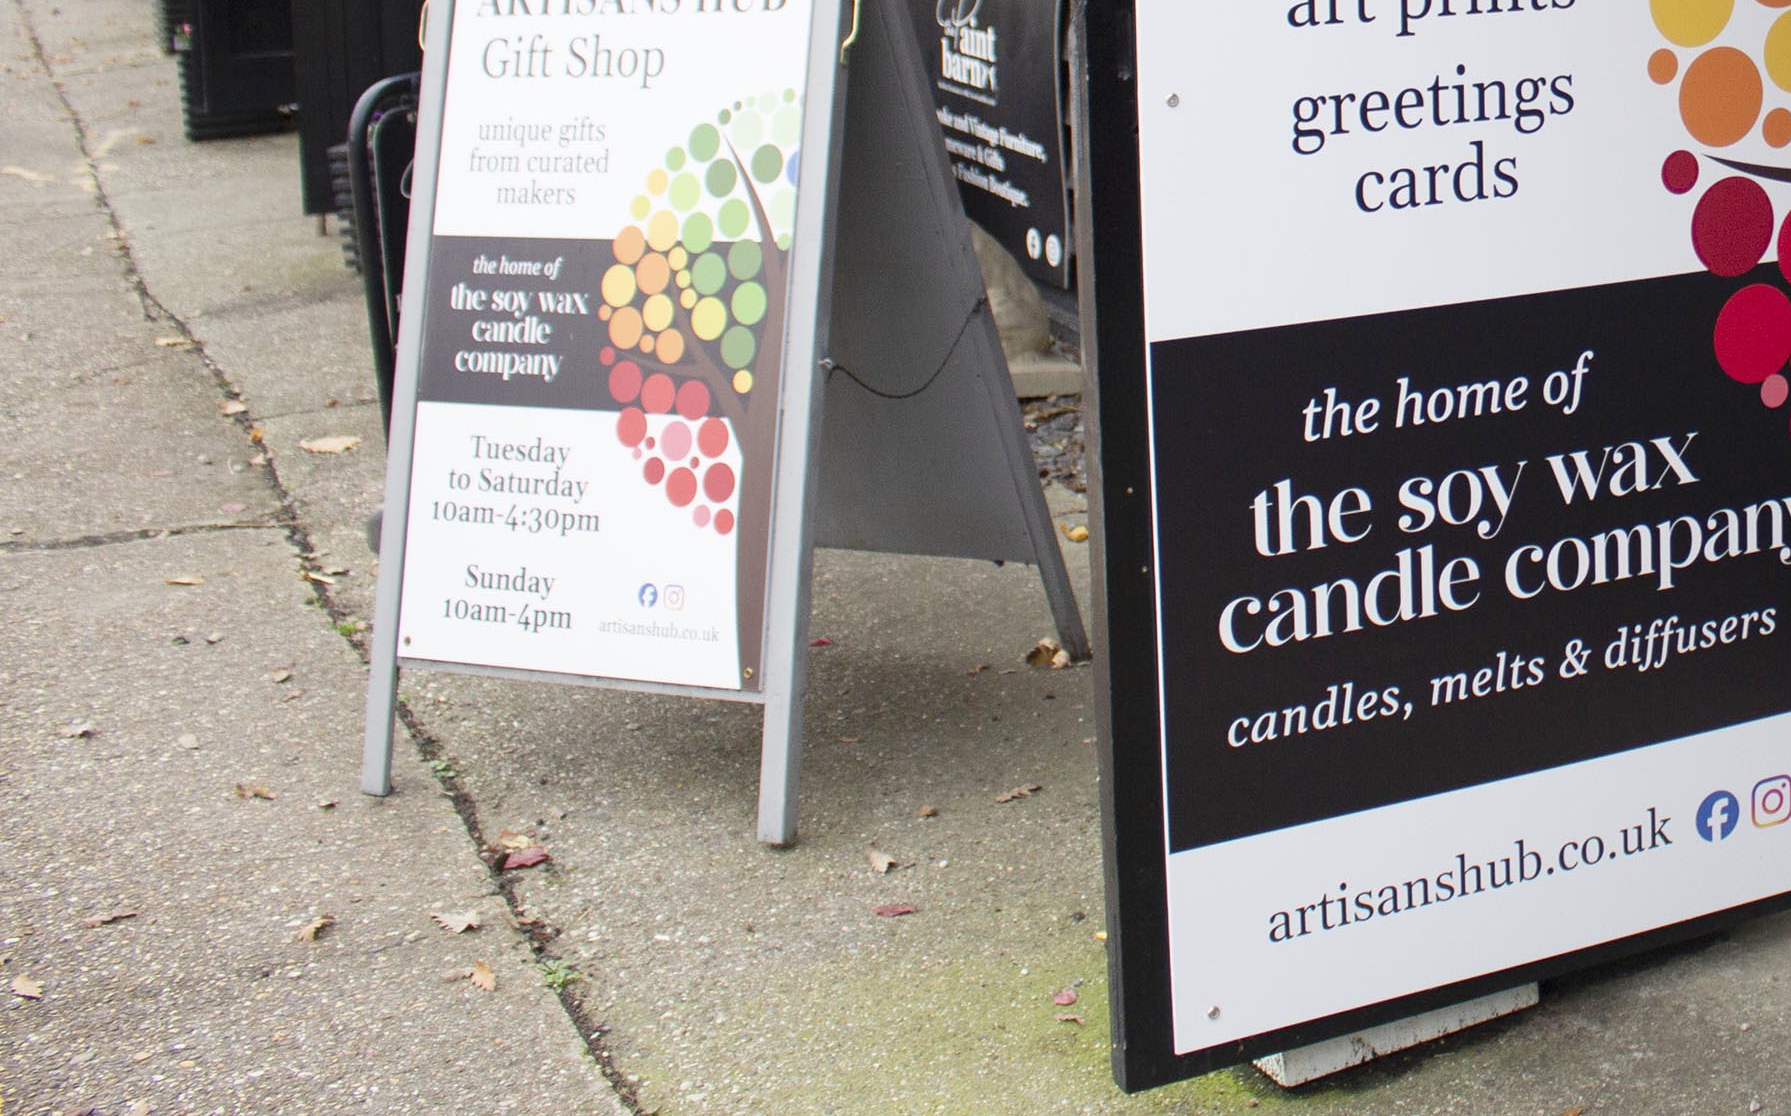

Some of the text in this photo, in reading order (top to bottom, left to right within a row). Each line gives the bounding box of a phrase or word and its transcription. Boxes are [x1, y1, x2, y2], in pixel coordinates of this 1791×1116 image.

[482, 35, 665, 88] Gift Shop
[1292, 65, 1576, 155] greetings
[478, 117, 606, 147] unique gifts
[469, 148, 609, 173] from curated
[1355, 141, 1519, 213] cards
[496, 181, 575, 205] makers
[473, 255, 563, 279] the home of
[450, 283, 588, 318] the soy wax
[472, 315, 551, 345] candle
[455, 350, 563, 381] company
[1302, 351, 1594, 442] the home of
[470, 435, 571, 466] Tuesday
[448, 468, 589, 499] to Saturday
[1250, 432, 1699, 556] the soy wax
[432, 501, 600, 536] 10am-4:30pm
[465, 564, 555, 599] Sunday
[1218, 544, 1480, 653] candle
[442, 599, 573, 631] 10am-4pm
[598, 618, 719, 643] artisanshub.co.uk
[1228, 604, 1777, 747] candles, melts & diffusers
[1269, 808, 1673, 943] artisanshub.co.uk
